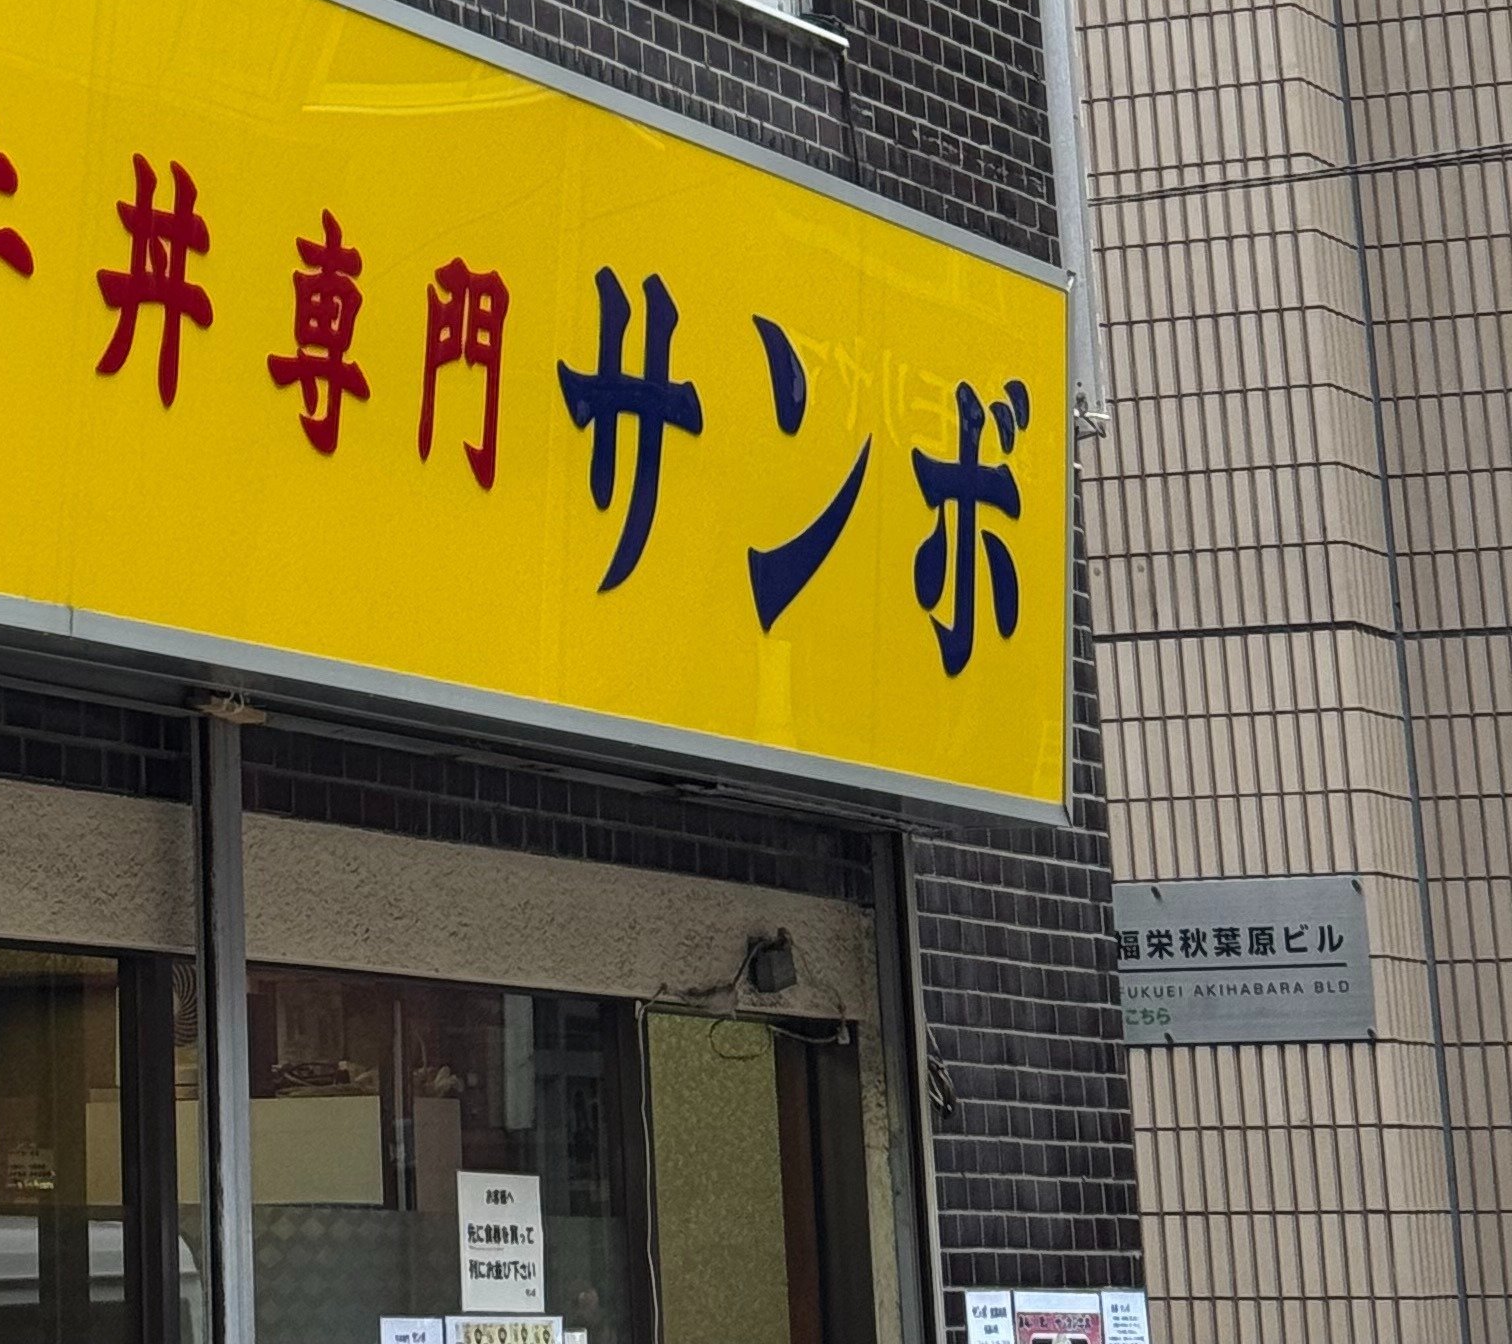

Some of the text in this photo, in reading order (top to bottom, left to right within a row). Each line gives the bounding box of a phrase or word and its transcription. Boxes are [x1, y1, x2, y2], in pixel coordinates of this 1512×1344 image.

[557, 265, 1032, 679] サンボ
[1193, 981, 1304, 998] AKIHABARA
[1314, 980, 1350, 994] BLD
